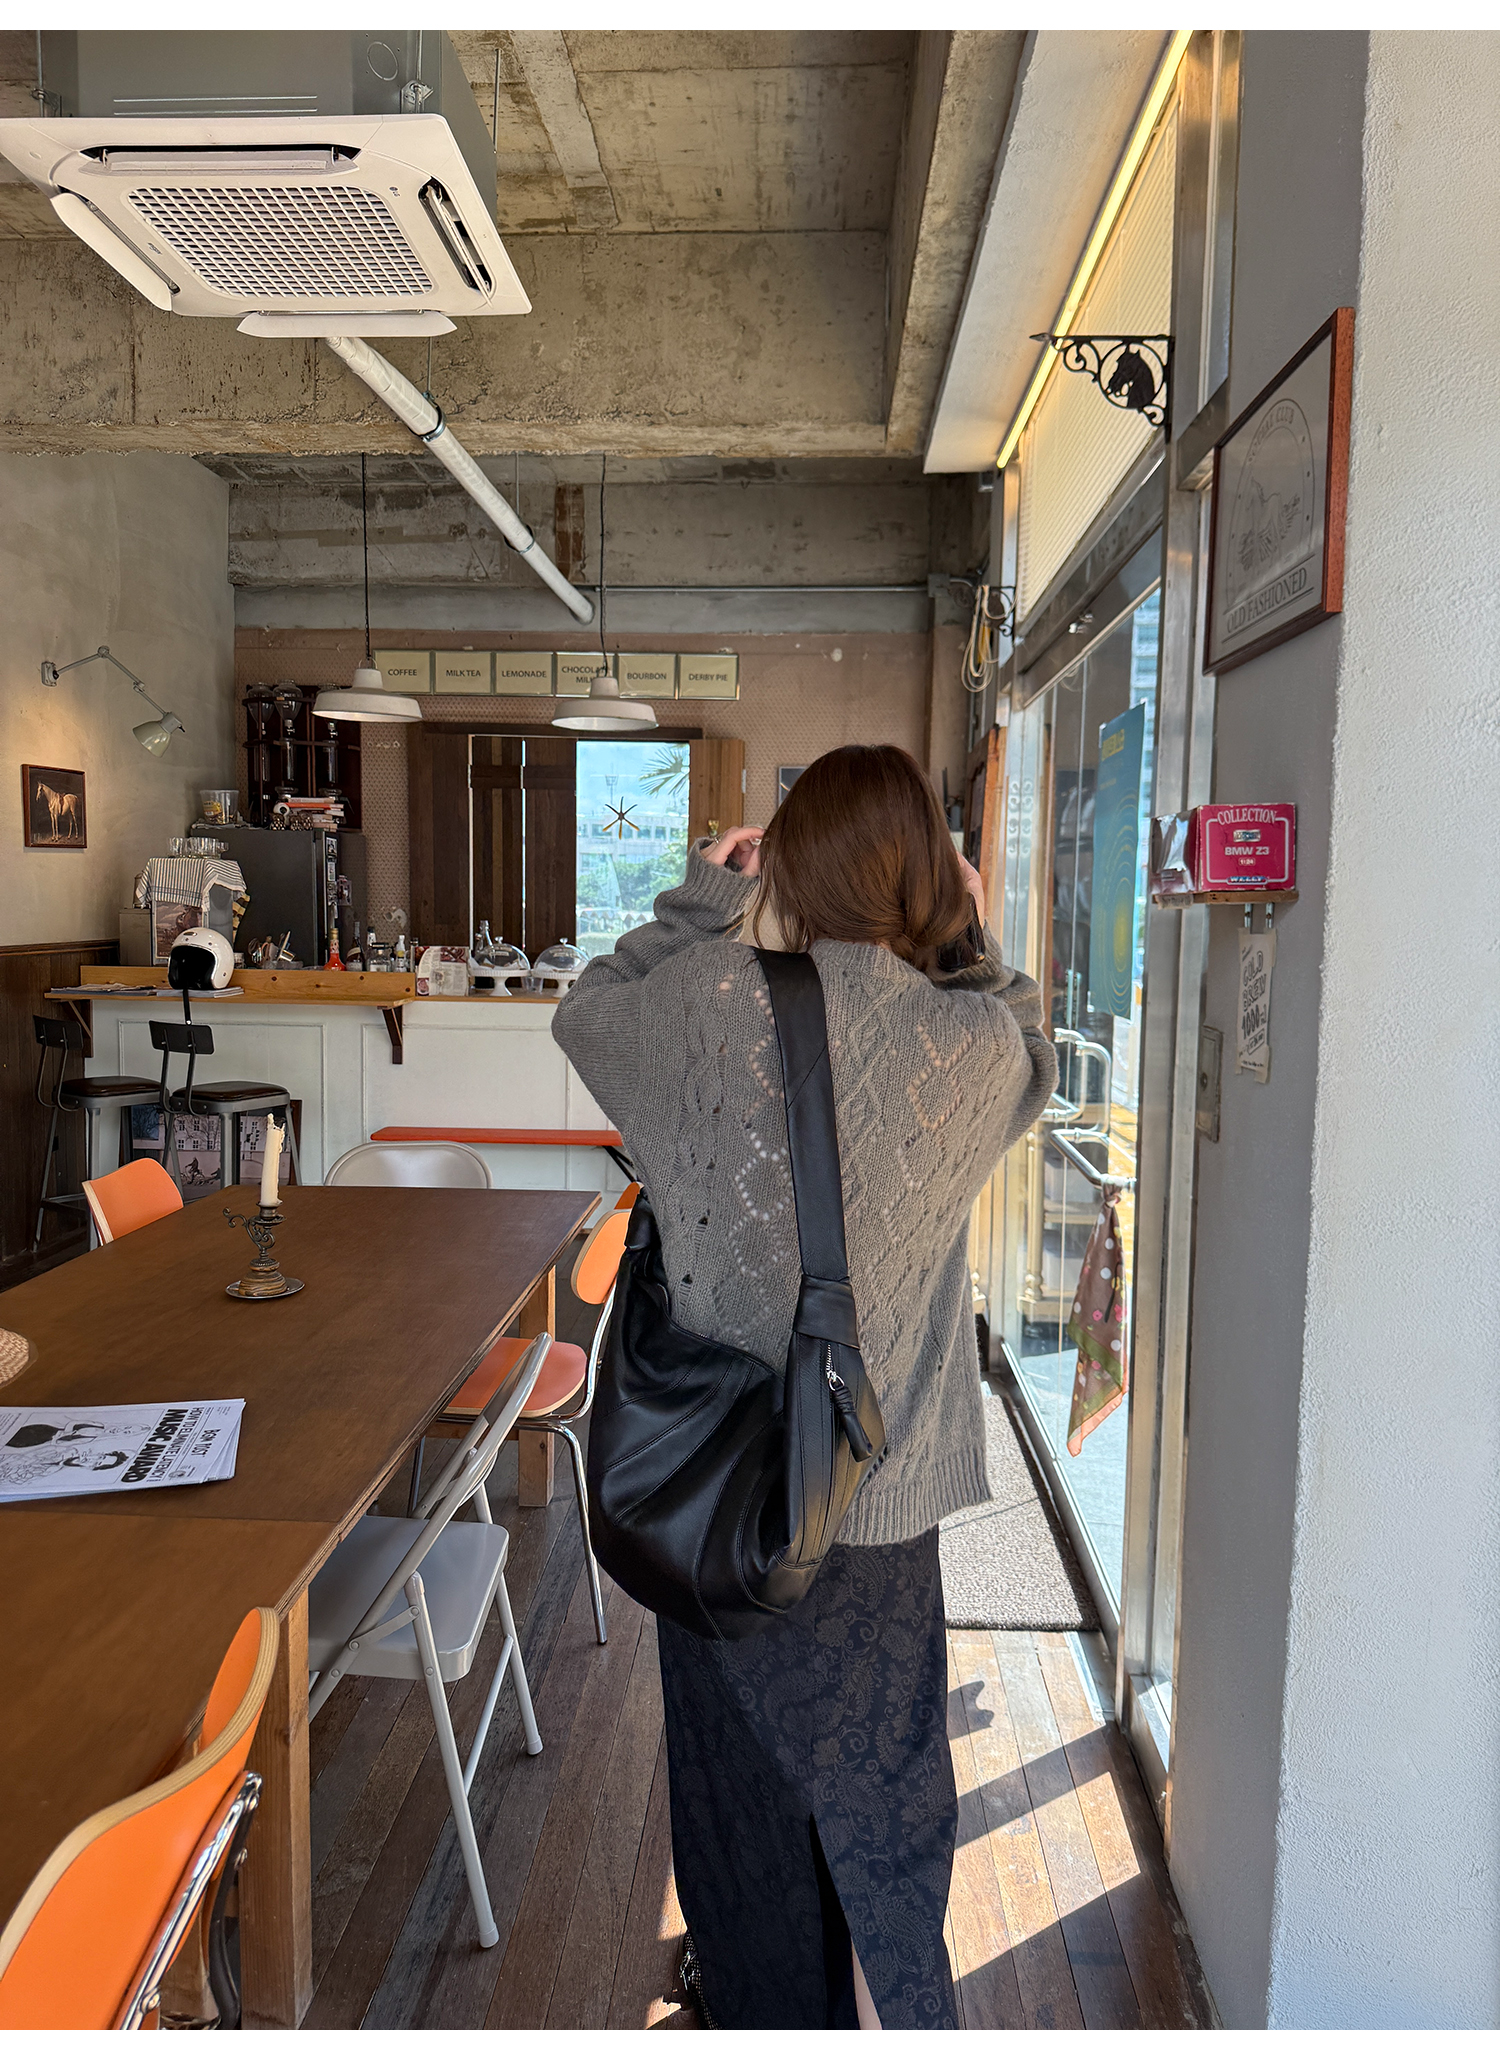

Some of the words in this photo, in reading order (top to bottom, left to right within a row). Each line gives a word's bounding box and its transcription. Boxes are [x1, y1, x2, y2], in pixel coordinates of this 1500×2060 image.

[1227, 606, 1246, 634] OLD
[1247, 567, 1307, 622] FASHIONED
[387, 668, 418, 677] COFFEE
[445, 669, 466, 678] MILK
[466, 669, 482, 678] TEA
[501, 670, 548, 679] LEMONADE
[626, 672, 667, 681] BOURBON
[688, 673, 714, 682] DERBY
[715, 673, 729, 682] PIE
[1217, 808, 1277, 826] COLLECTION
[1224, 846, 1253, 856] BMW
[1255, 846, 1270, 856] Z3
[1243, 950, 1264, 987] COLD
[1243, 973, 1267, 1013] BREW
[186, 1406, 205, 1420] HOW
[147, 1408, 189, 1442] MUSIC
[165, 1427, 194, 1455] ELIMINATE
[121, 1443, 167, 1483] AWARD
[148, 1454, 177, 1479] LATENCY
